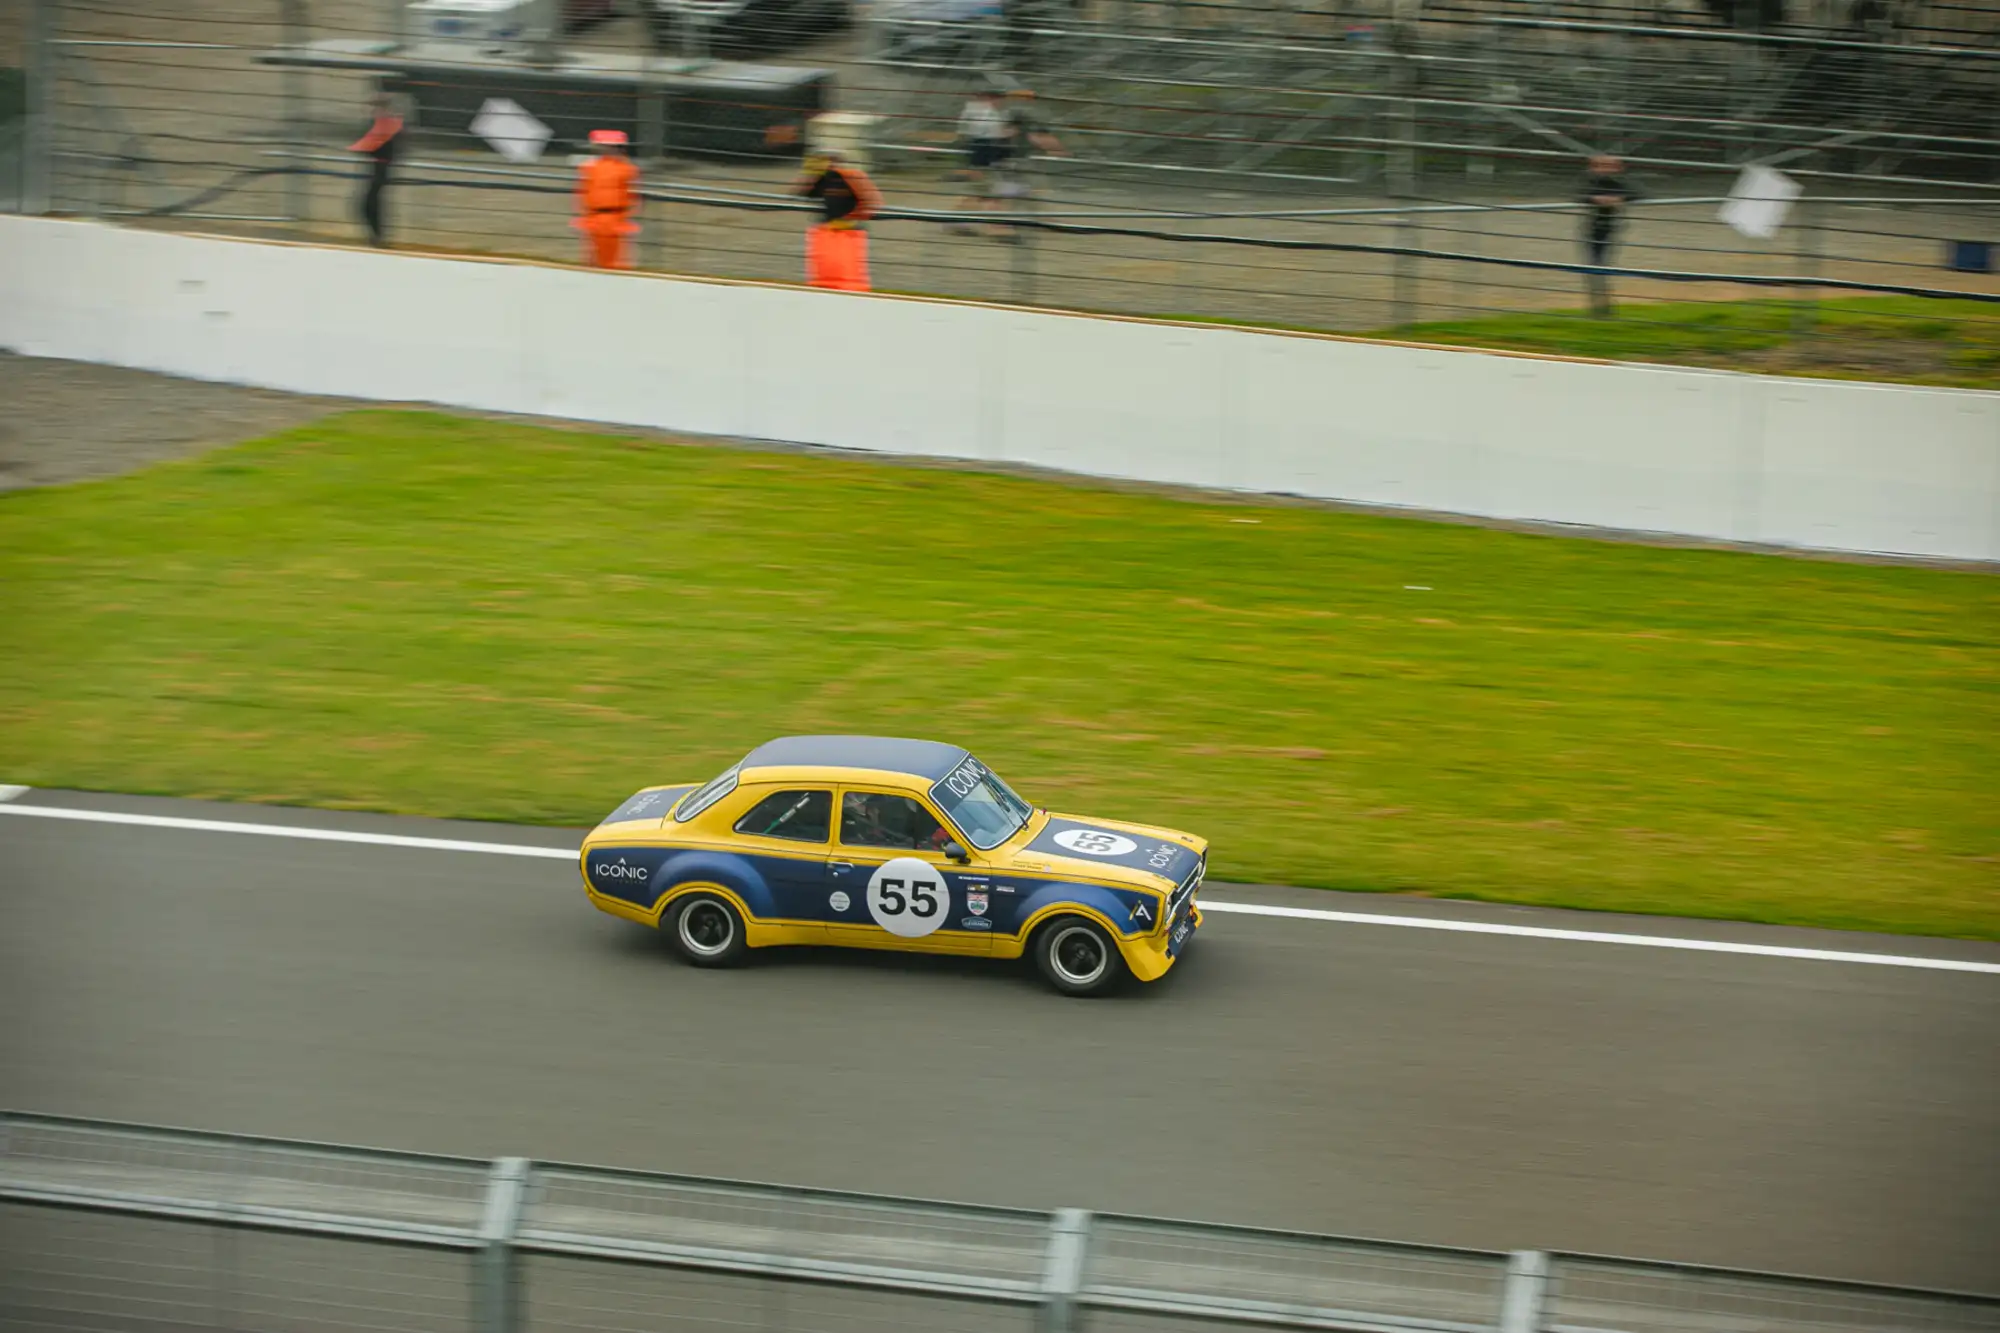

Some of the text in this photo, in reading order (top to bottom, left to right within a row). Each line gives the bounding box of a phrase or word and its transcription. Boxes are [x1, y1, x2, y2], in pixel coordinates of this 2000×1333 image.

[945, 759, 986, 798] ICONIC
[1072, 832, 1118, 852] 55
[595, 864, 648, 880] ICONIC
[878, 878, 938, 918] 55
